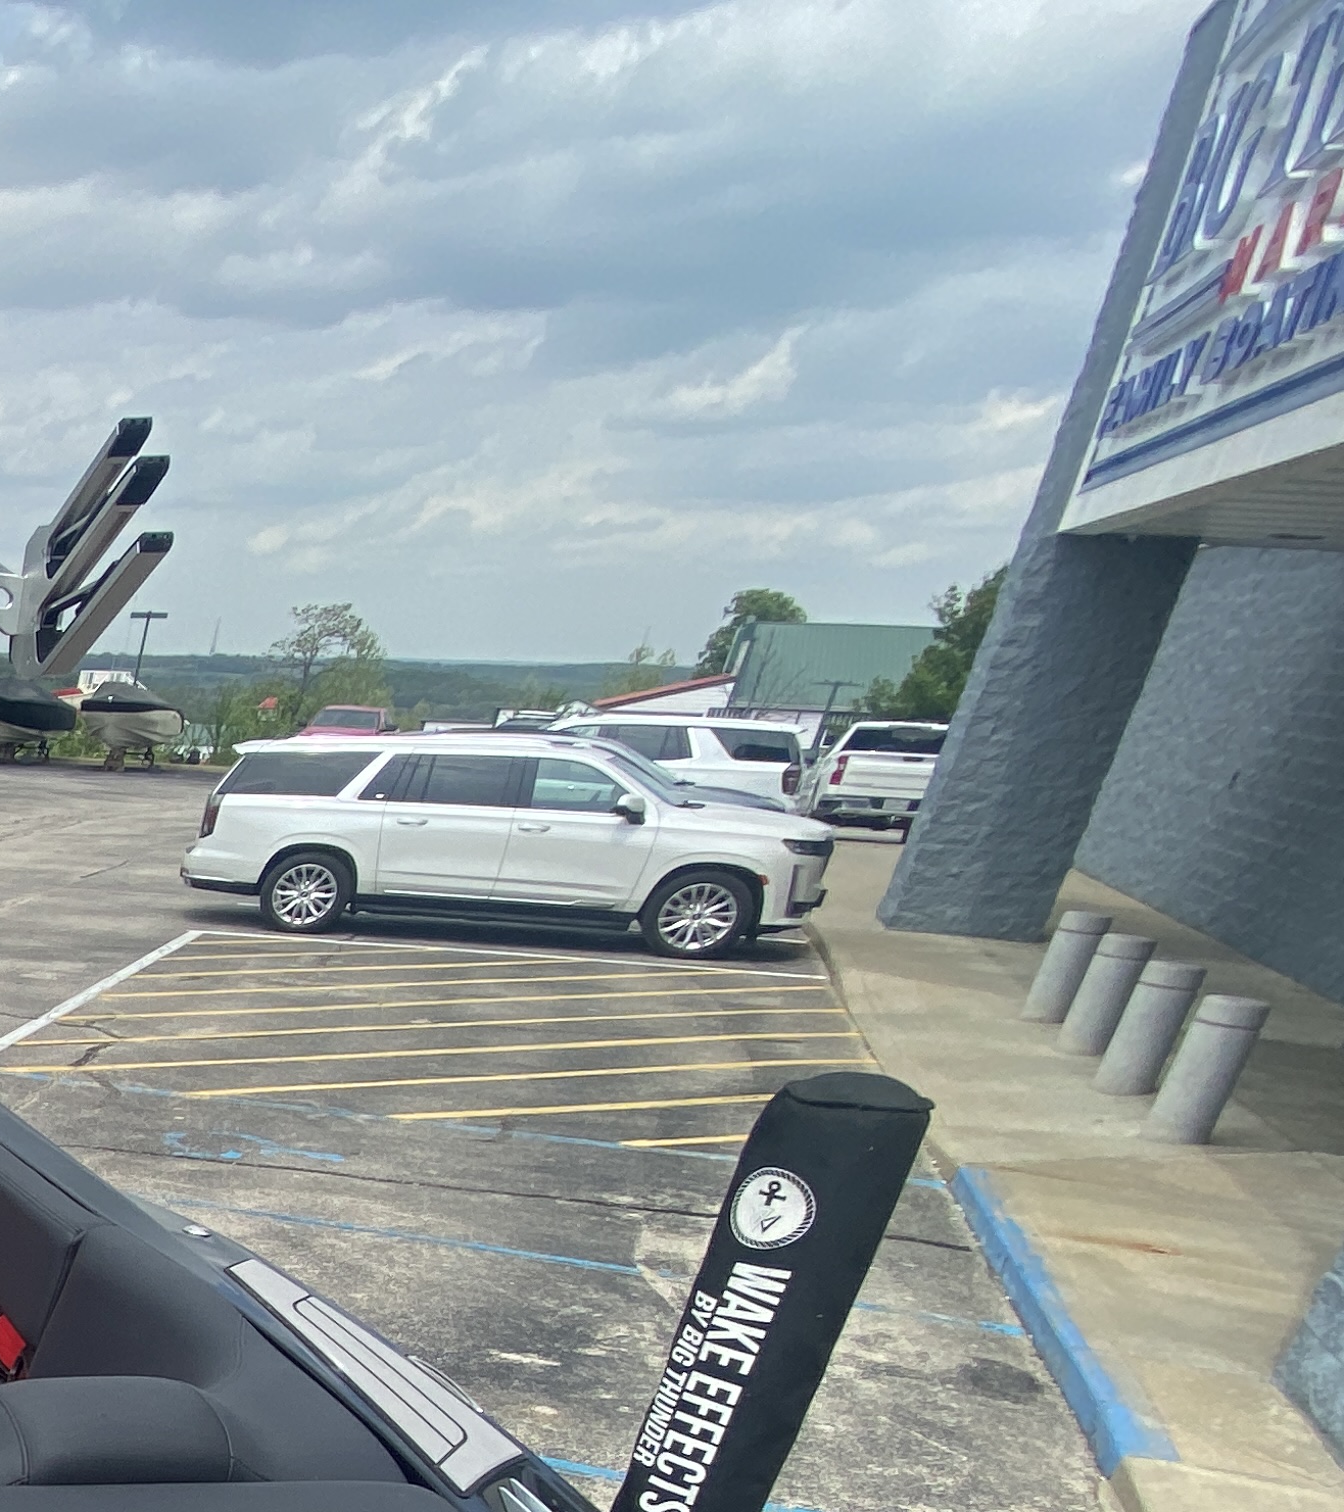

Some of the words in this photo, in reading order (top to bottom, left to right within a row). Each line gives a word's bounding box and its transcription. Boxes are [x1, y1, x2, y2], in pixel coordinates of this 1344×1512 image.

[1217, 166, 1344, 304] MAR
[671, 1323, 704, 1367] BIG
[690, 1290, 718, 1328] BY
[698, 1262, 792, 1376] WAKE
[633, 1367, 688, 1468] THUNDER
